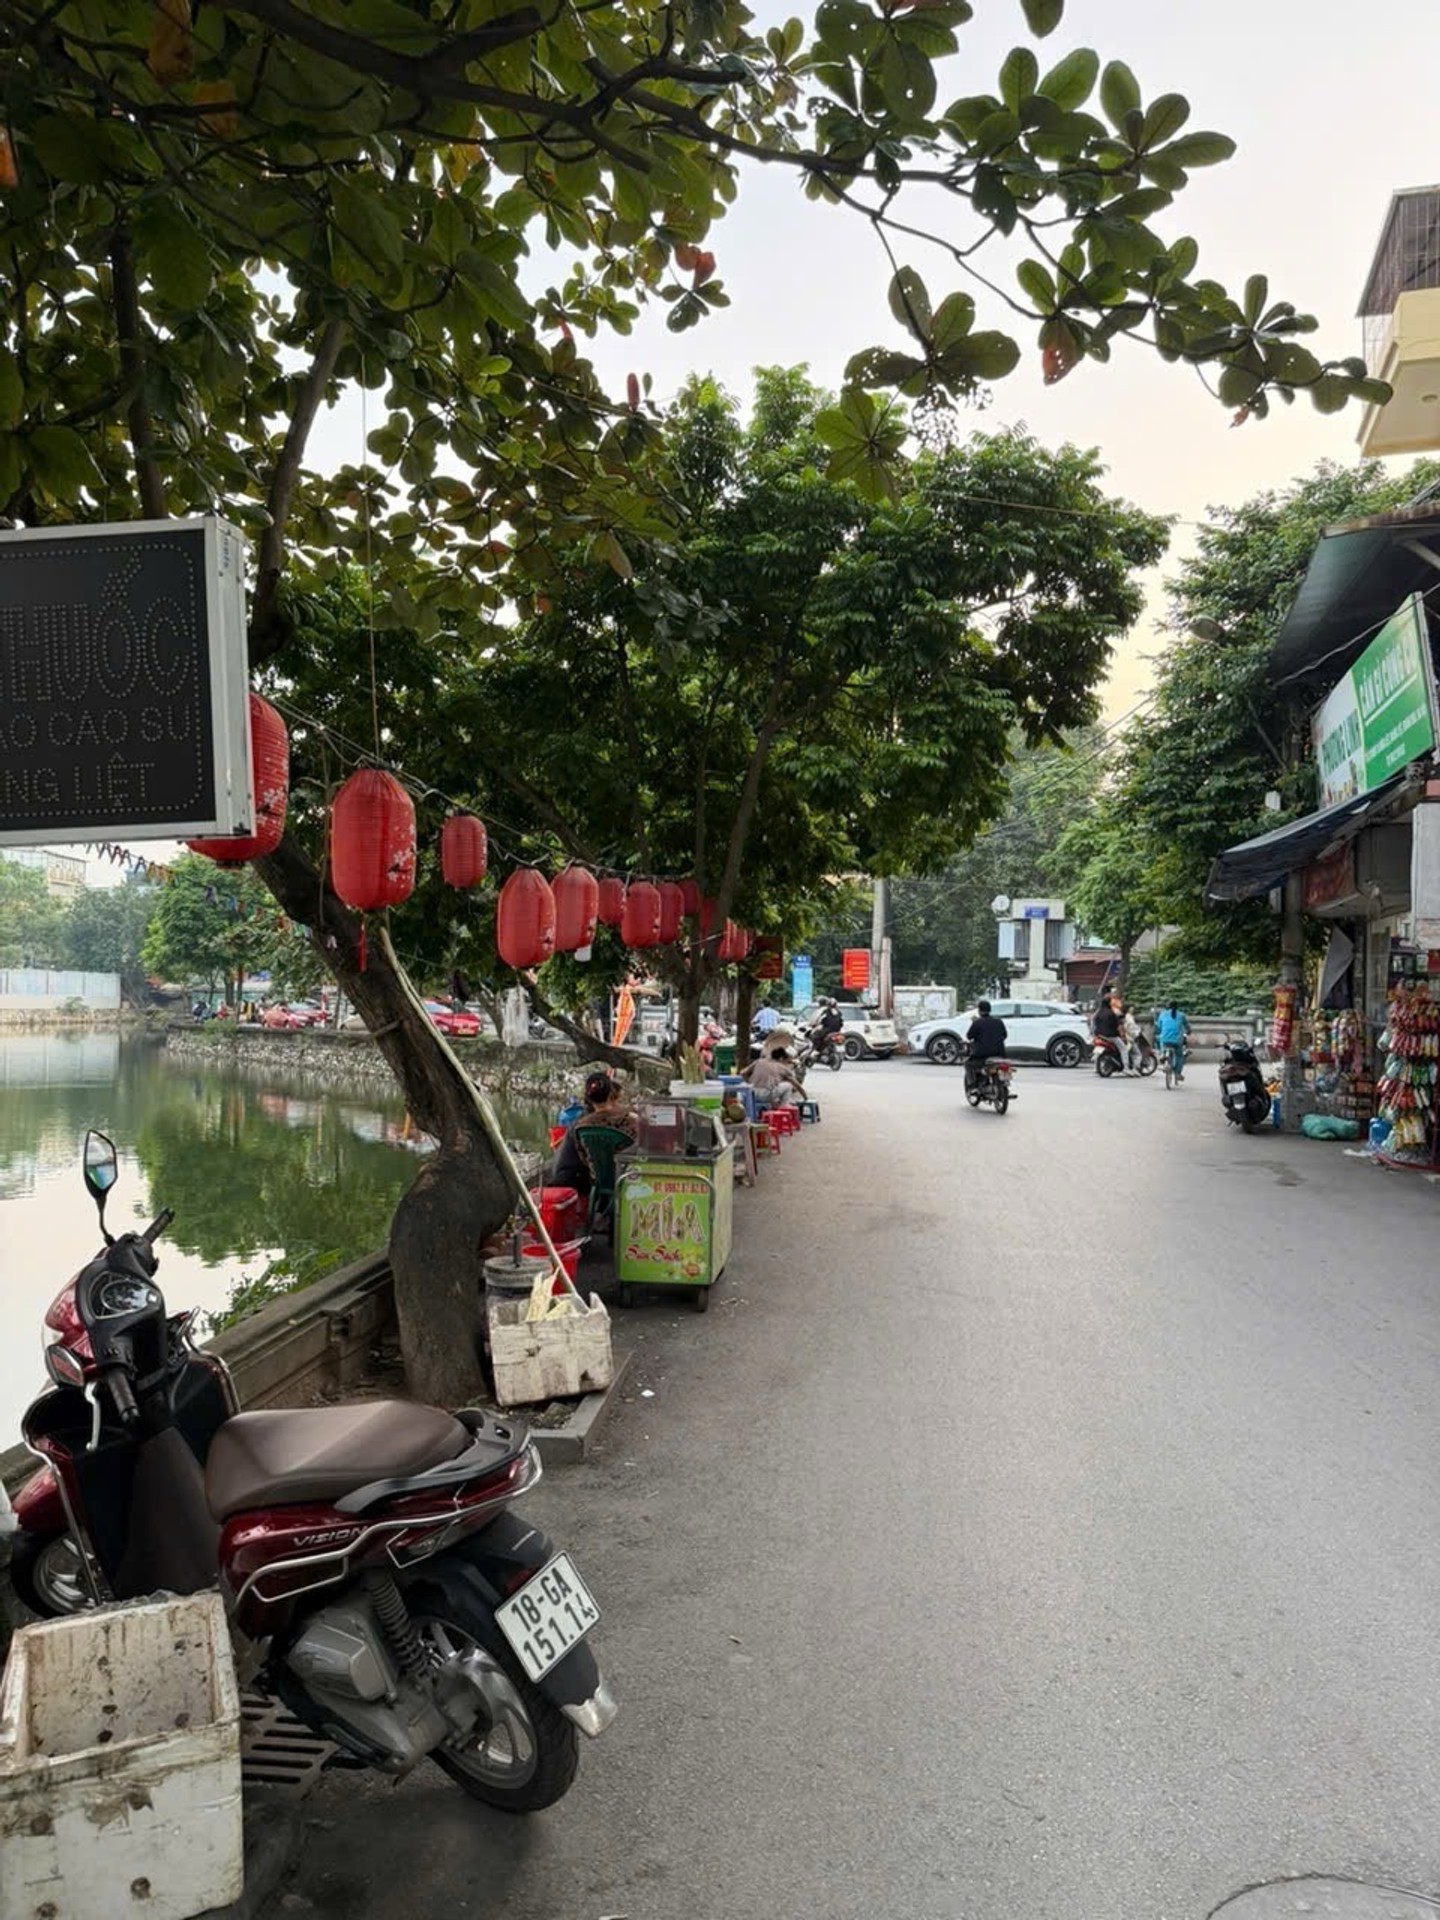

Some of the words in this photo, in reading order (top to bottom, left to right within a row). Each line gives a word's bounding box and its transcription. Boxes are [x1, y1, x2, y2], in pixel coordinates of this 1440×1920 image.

[48, 708, 129, 745] CAO
[140, 705, 191, 743] SU
[0, 767, 60, 806] NG
[74, 751, 155, 807] LIỆT
[292, 1525, 369, 1547] VISION
[510, 1567, 573, 1633] 18-GA
